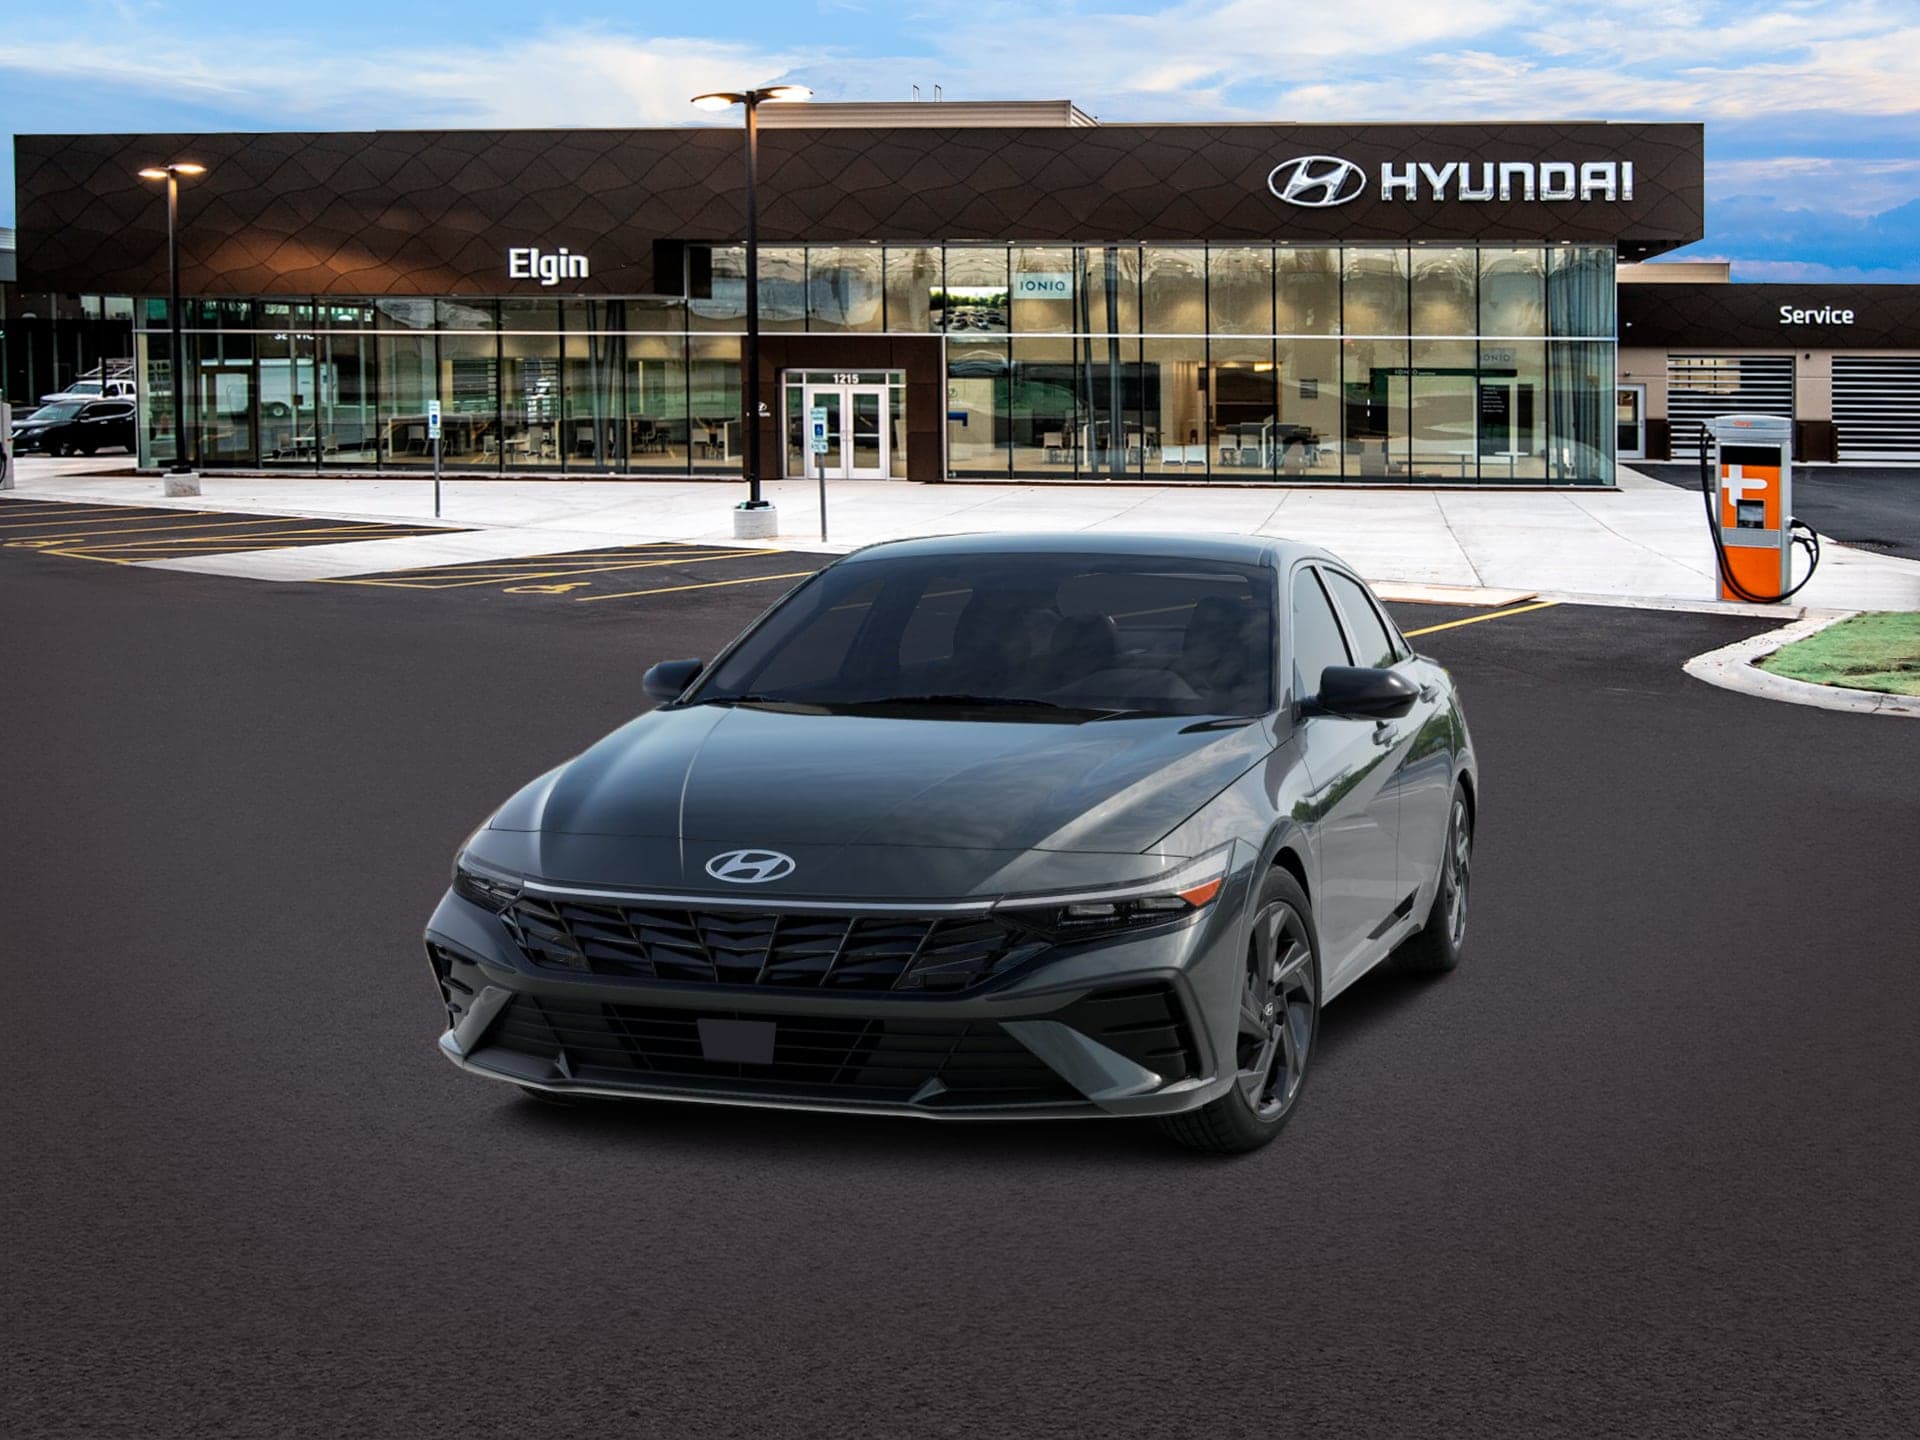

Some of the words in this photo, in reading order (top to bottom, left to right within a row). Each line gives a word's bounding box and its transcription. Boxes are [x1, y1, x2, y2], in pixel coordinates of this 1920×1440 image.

[1381, 162, 1634, 201] HYUNDAI
[509, 247, 589, 286] Elgin
[1020, 280, 1065, 291] IONIQ
[1779, 305, 1854, 324] Service
[833, 374, 859, 384] 1215
